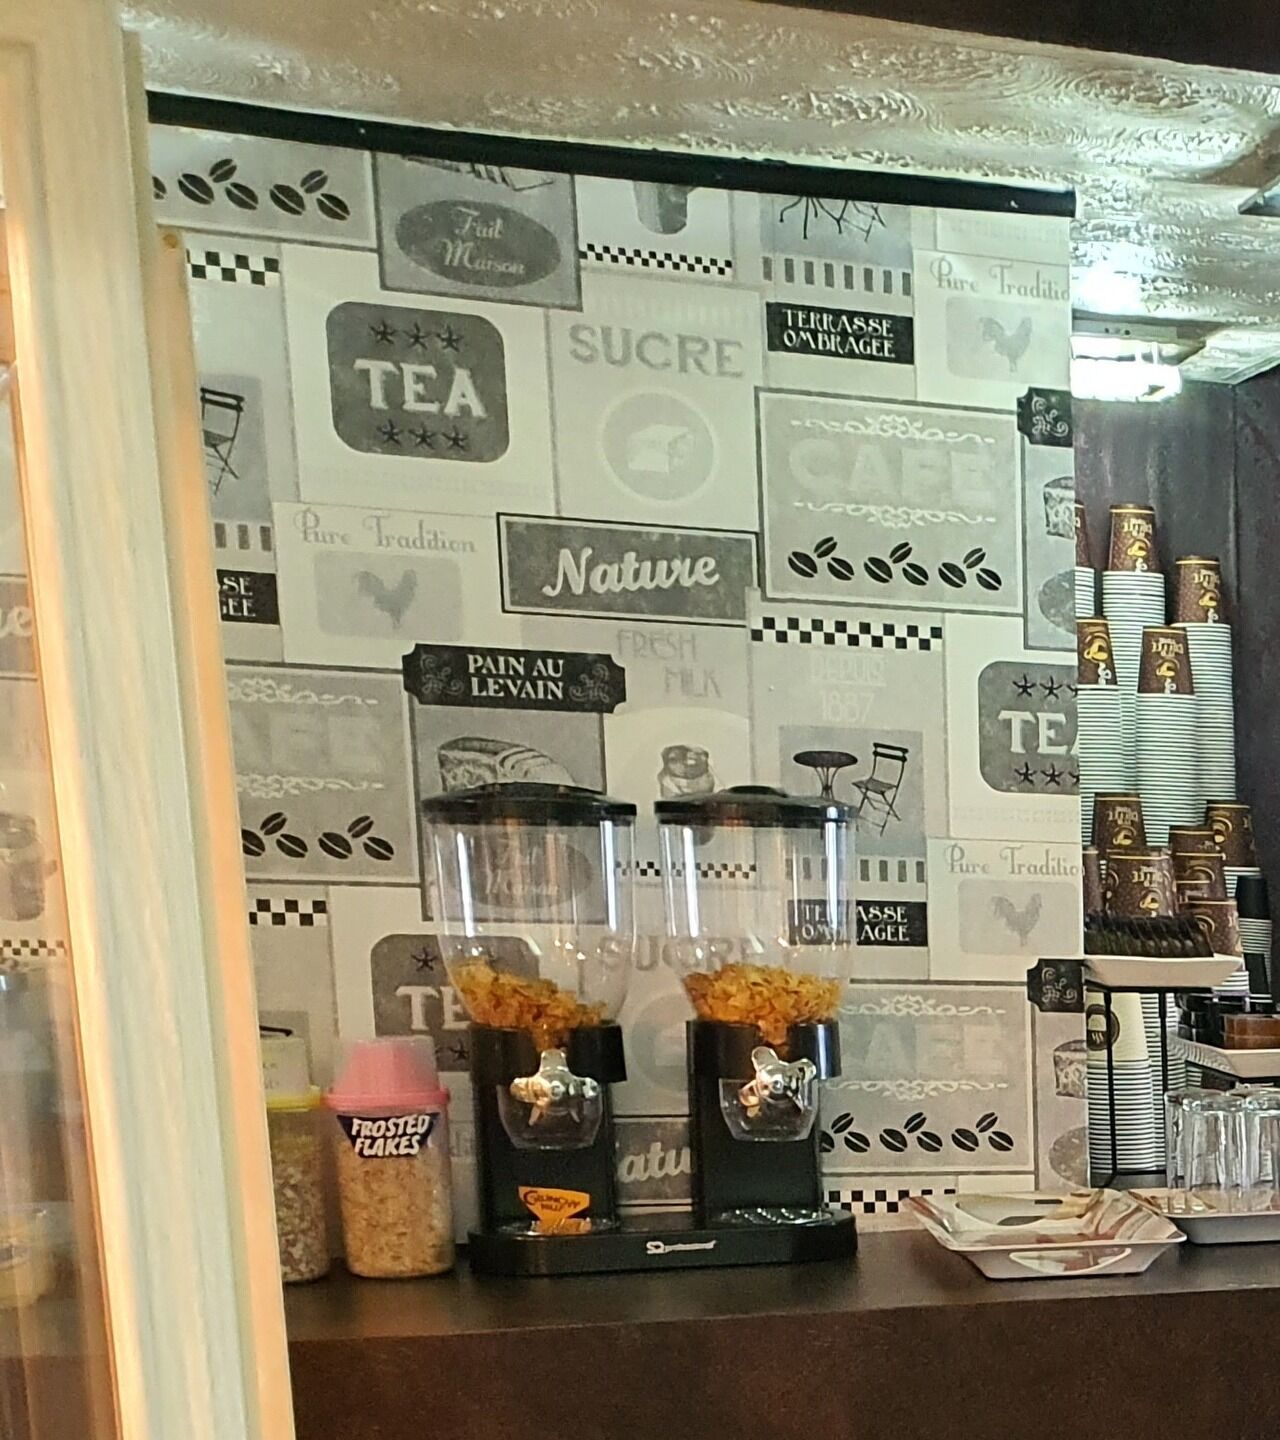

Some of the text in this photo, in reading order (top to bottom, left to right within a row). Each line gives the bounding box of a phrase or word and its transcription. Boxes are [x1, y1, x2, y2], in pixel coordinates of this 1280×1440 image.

[781, 308, 895, 338] TERRASSE
[569, 323, 744, 378] SUCRE
[353, 358, 488, 418] TEA
[293, 506, 475, 553] Pure Tradition
[541, 546, 720, 597] Nature
[616, 628, 698, 661] FRESH
[467, 653, 564, 678] PAIN AU
[471, 677, 563, 700] LEVAIN
[998, 710, 1079, 755] TE
[944, 843, 991, 874] Pure
[351, 1114, 430, 1138] FROSTED
[354, 1135, 421, 1156] FLAKES
